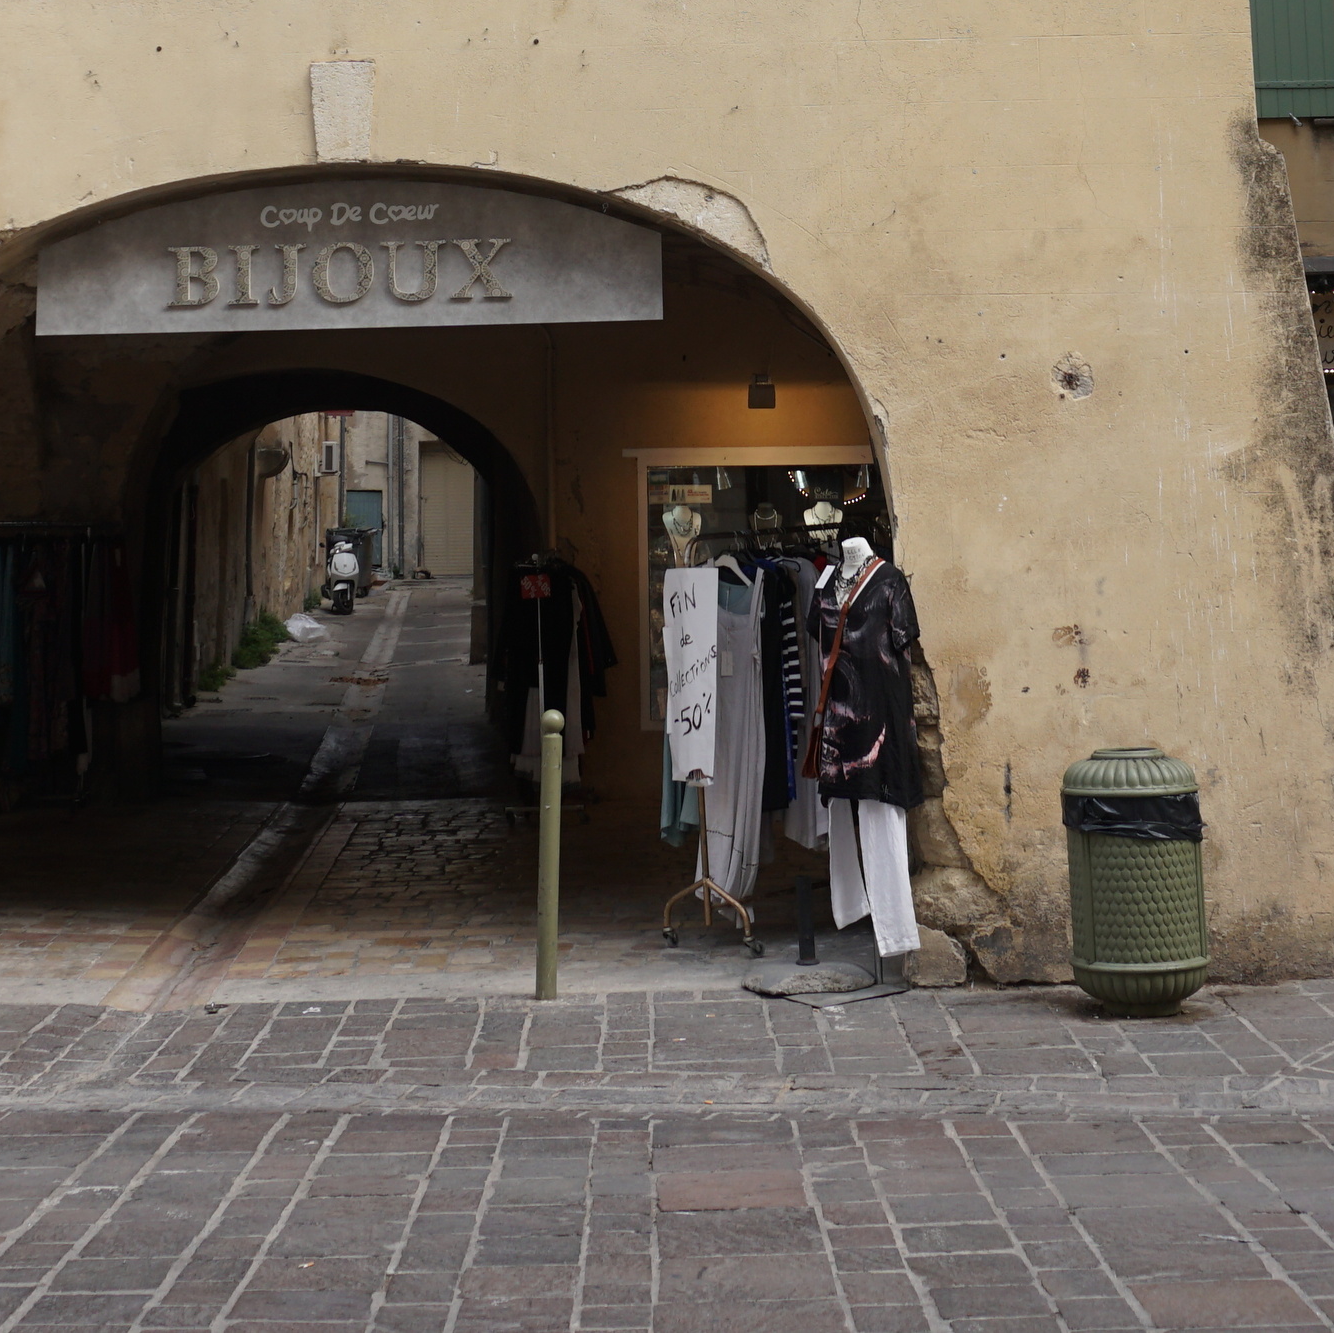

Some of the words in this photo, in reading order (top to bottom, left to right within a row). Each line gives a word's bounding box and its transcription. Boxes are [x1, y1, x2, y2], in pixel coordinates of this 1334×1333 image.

[331, 202, 363, 226] De
[166, 237, 514, 312] BIJOUX
[679, 627, 693, 648] de
